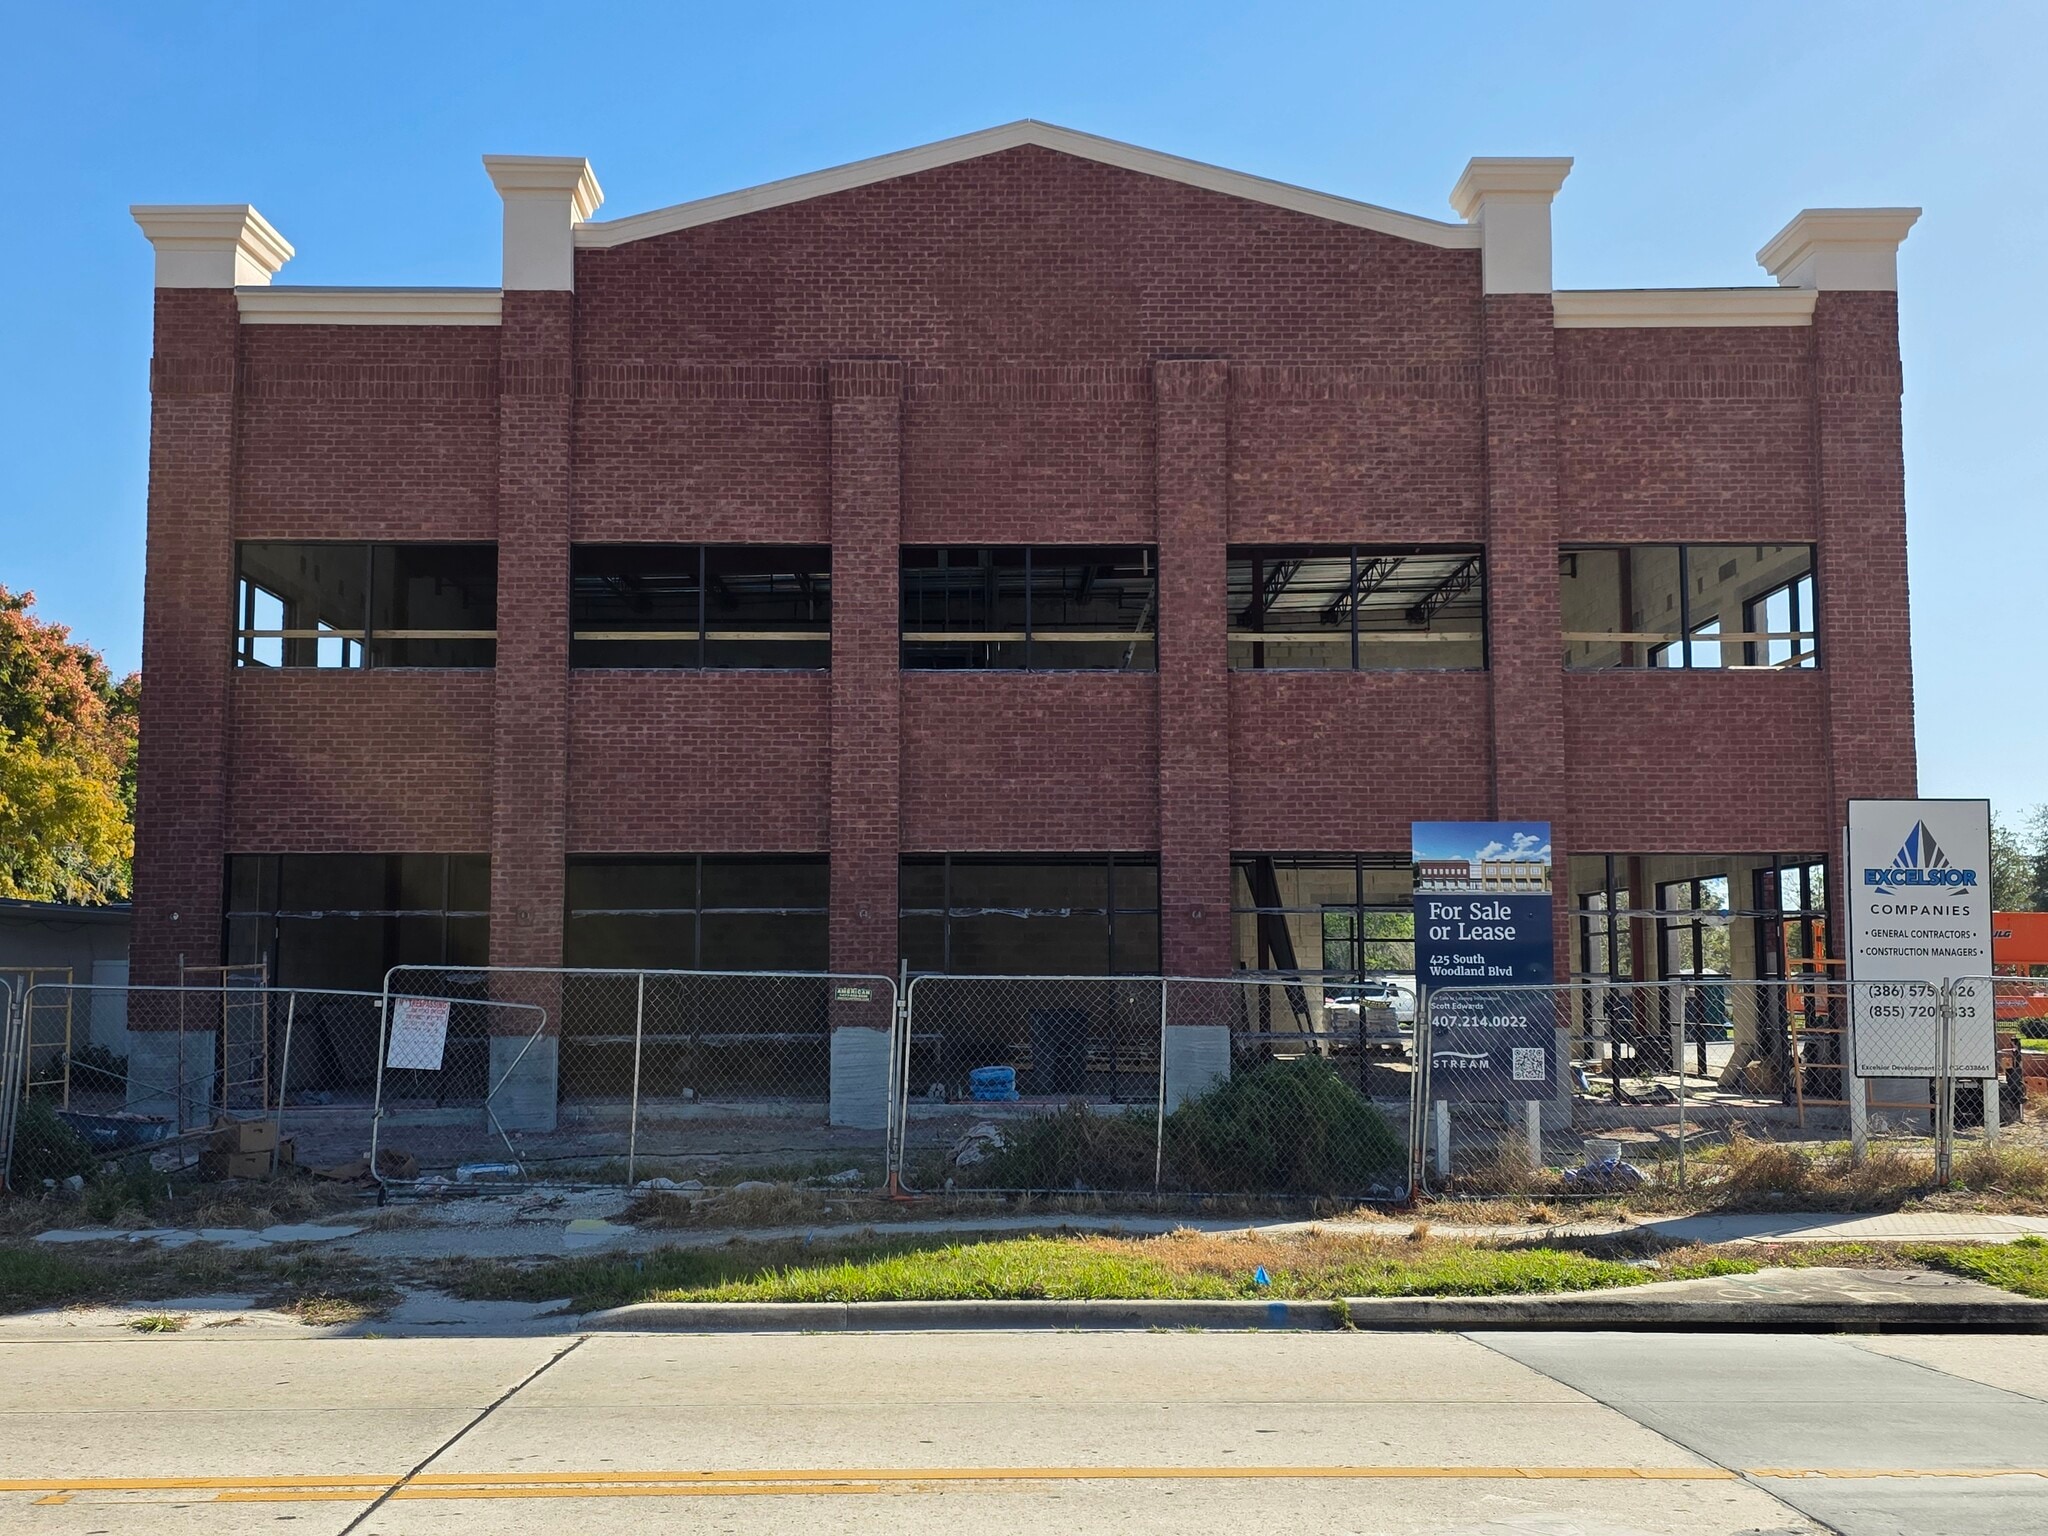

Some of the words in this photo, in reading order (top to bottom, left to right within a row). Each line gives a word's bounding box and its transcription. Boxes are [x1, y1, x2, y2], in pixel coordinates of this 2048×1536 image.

[1864, 868, 1978, 886] EXCELSIOR
[1429, 902, 1462, 920] For
[1469, 901, 1512, 920] Sale
[1870, 904, 1970, 916] COMPANIES
[1429, 926, 1451, 940] or
[1458, 922, 1516, 941] Lease
[1871, 929, 1908, 938] GENERAL
[1910, 930, 1970, 939] CONTRACTORS
[1865, 947, 1929, 956] CONSTRUCTION
[1931, 948, 1978, 957] MANAGERS
[1429, 954, 1450, 966] 425
[1453, 954, 1485, 964] South
[1429, 965, 1485, 976] Woodland
[1488, 966, 1513, 976] Blvd
[1868, 985, 1905, 998] (386)
[1431, 1002, 1451, 1010] Scott
[1452, 1002, 1484, 1010] Edwards
[1869, 1005, 1905, 1019] (855)
[1432, 1016, 1527, 1027] 407.214.0022
[1433, 1060, 1489, 1069] STREAM
[1892, 1064, 1935, 1073] Development
